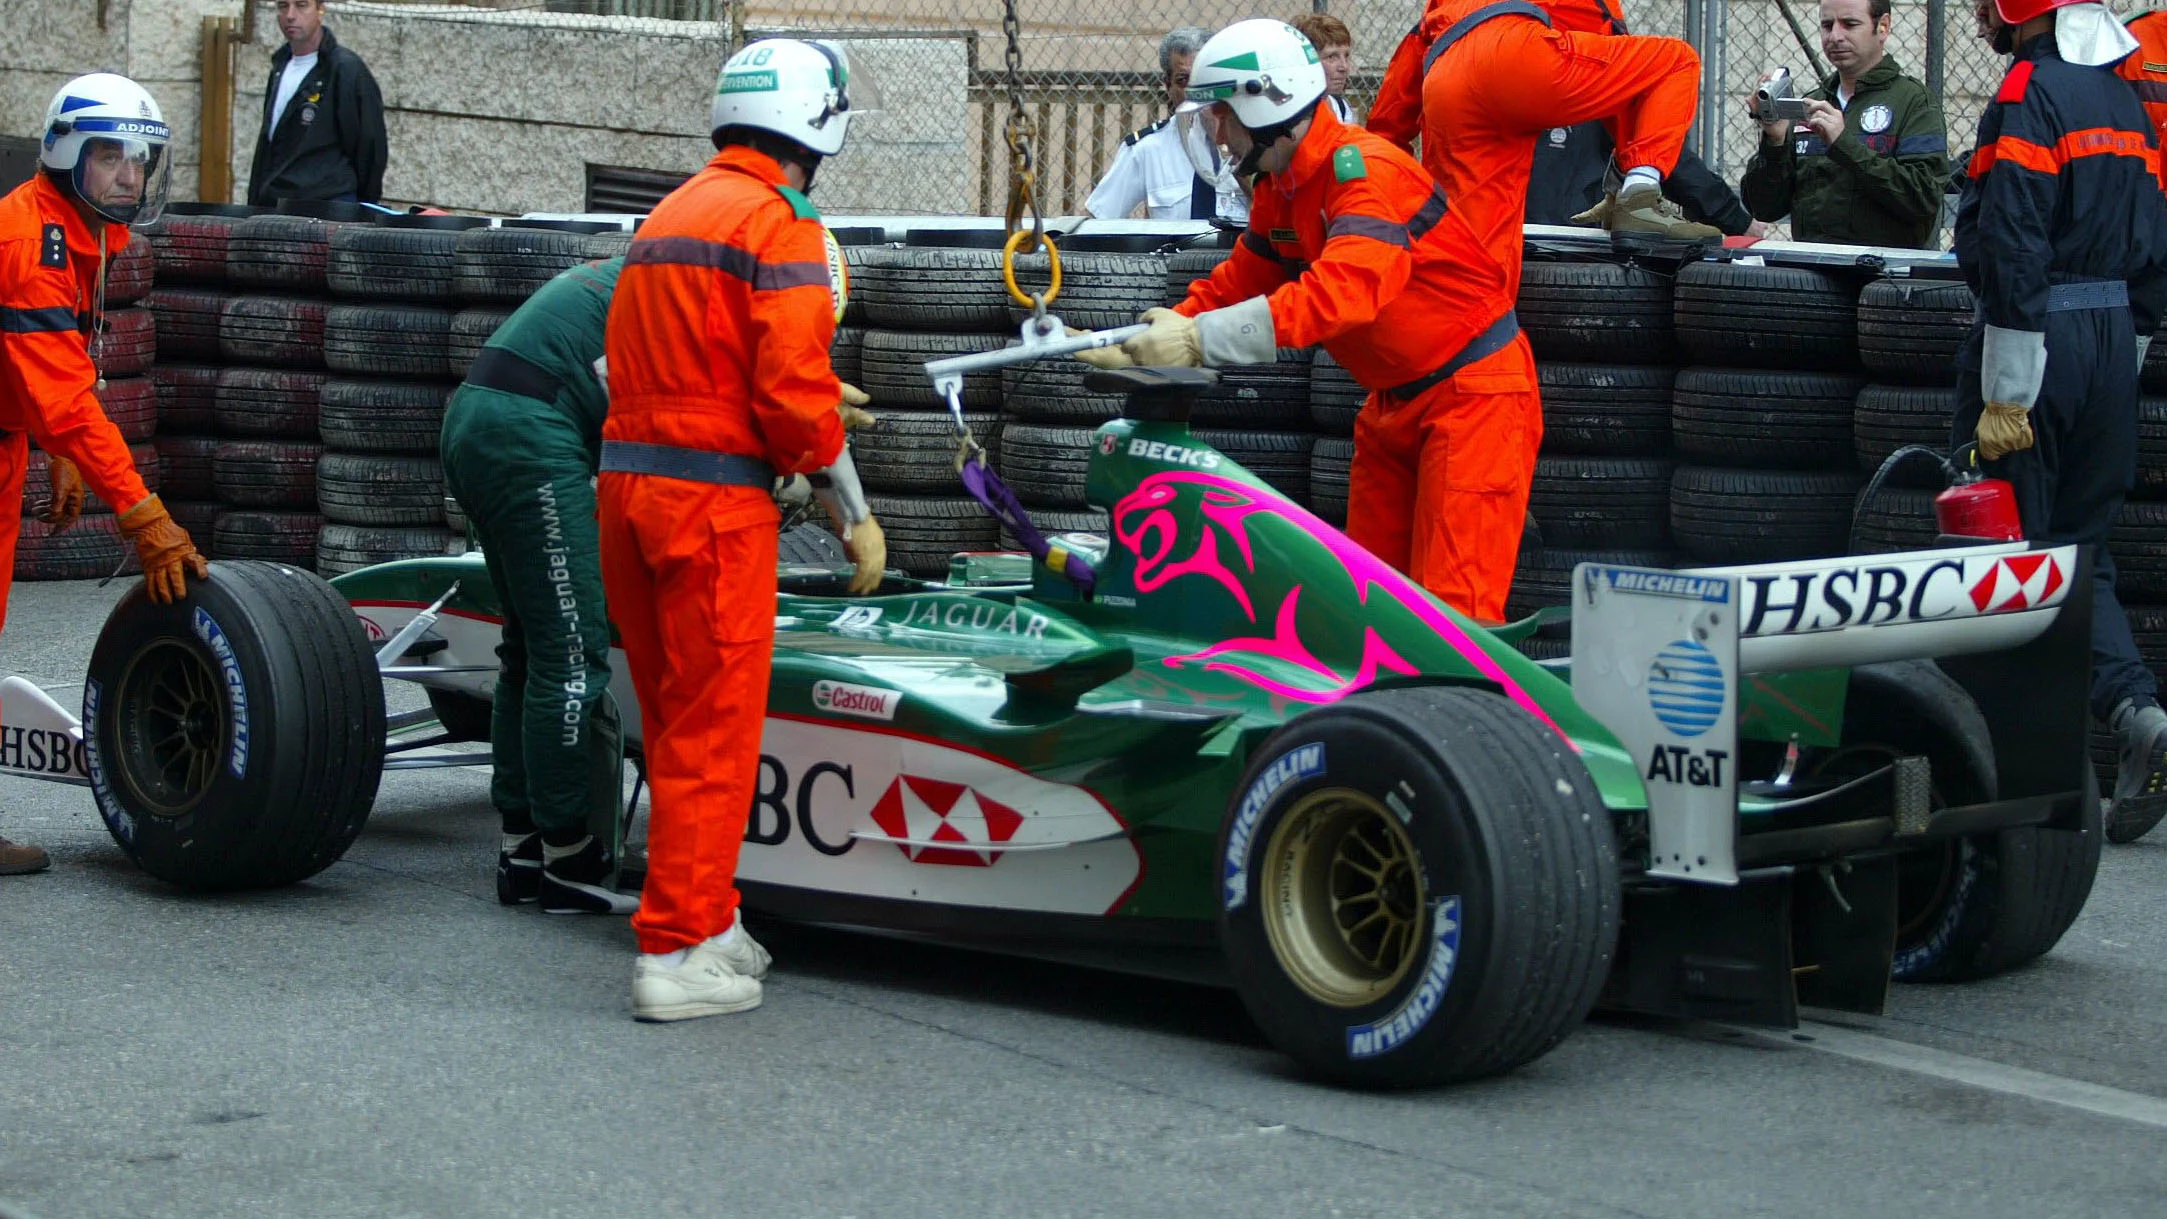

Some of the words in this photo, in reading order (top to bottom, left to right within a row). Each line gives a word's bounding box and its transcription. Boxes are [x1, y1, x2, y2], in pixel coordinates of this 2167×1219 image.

[536, 482, 587, 747] www.jaguar-racing.com
[900, 600, 1049, 640] JAGUAR
[1614, 572, 1726, 598] MICHELIN
[1744, 557, 1965, 635] HSBC
[211, 634, 247, 776] MICHELIN
[832, 686, 888, 713] Castrol
[84, 681, 119, 817] MICHELIN
[1646, 743, 1729, 788] AT&T
[1226, 745, 1321, 867] MICHELIN
[1351, 940, 1455, 1054] MICHELIN
